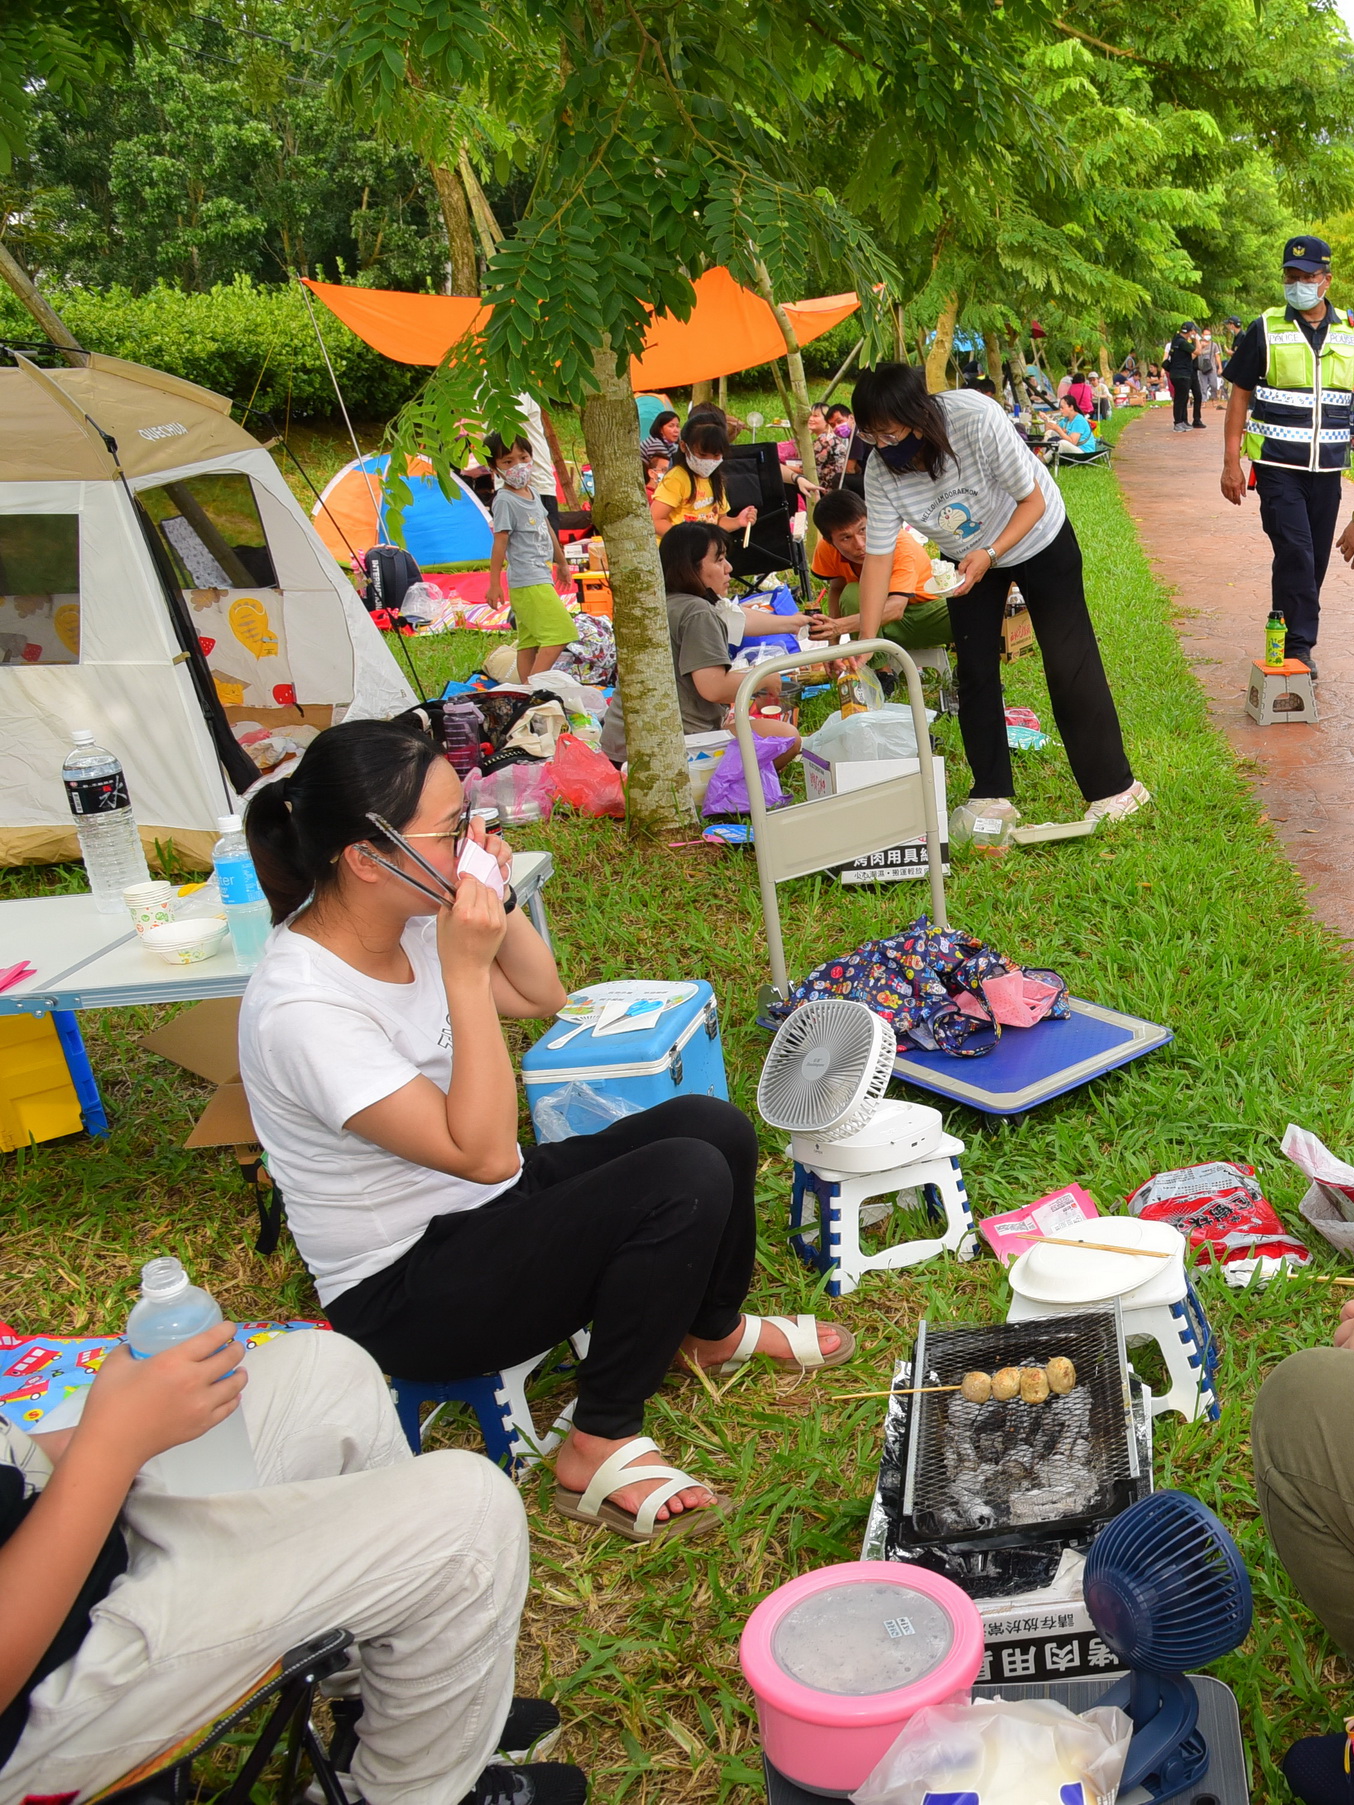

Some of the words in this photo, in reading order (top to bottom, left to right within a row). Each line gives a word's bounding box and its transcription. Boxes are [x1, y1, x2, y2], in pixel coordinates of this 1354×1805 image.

[1269, 333, 1298, 343] POLICE
[136, 421, 189, 442] QUECHUA
[944, 487, 978, 500] DORAEMON
[98, 775, 128, 809] 水
[982, 1613, 1075, 1637] 請存放於常
